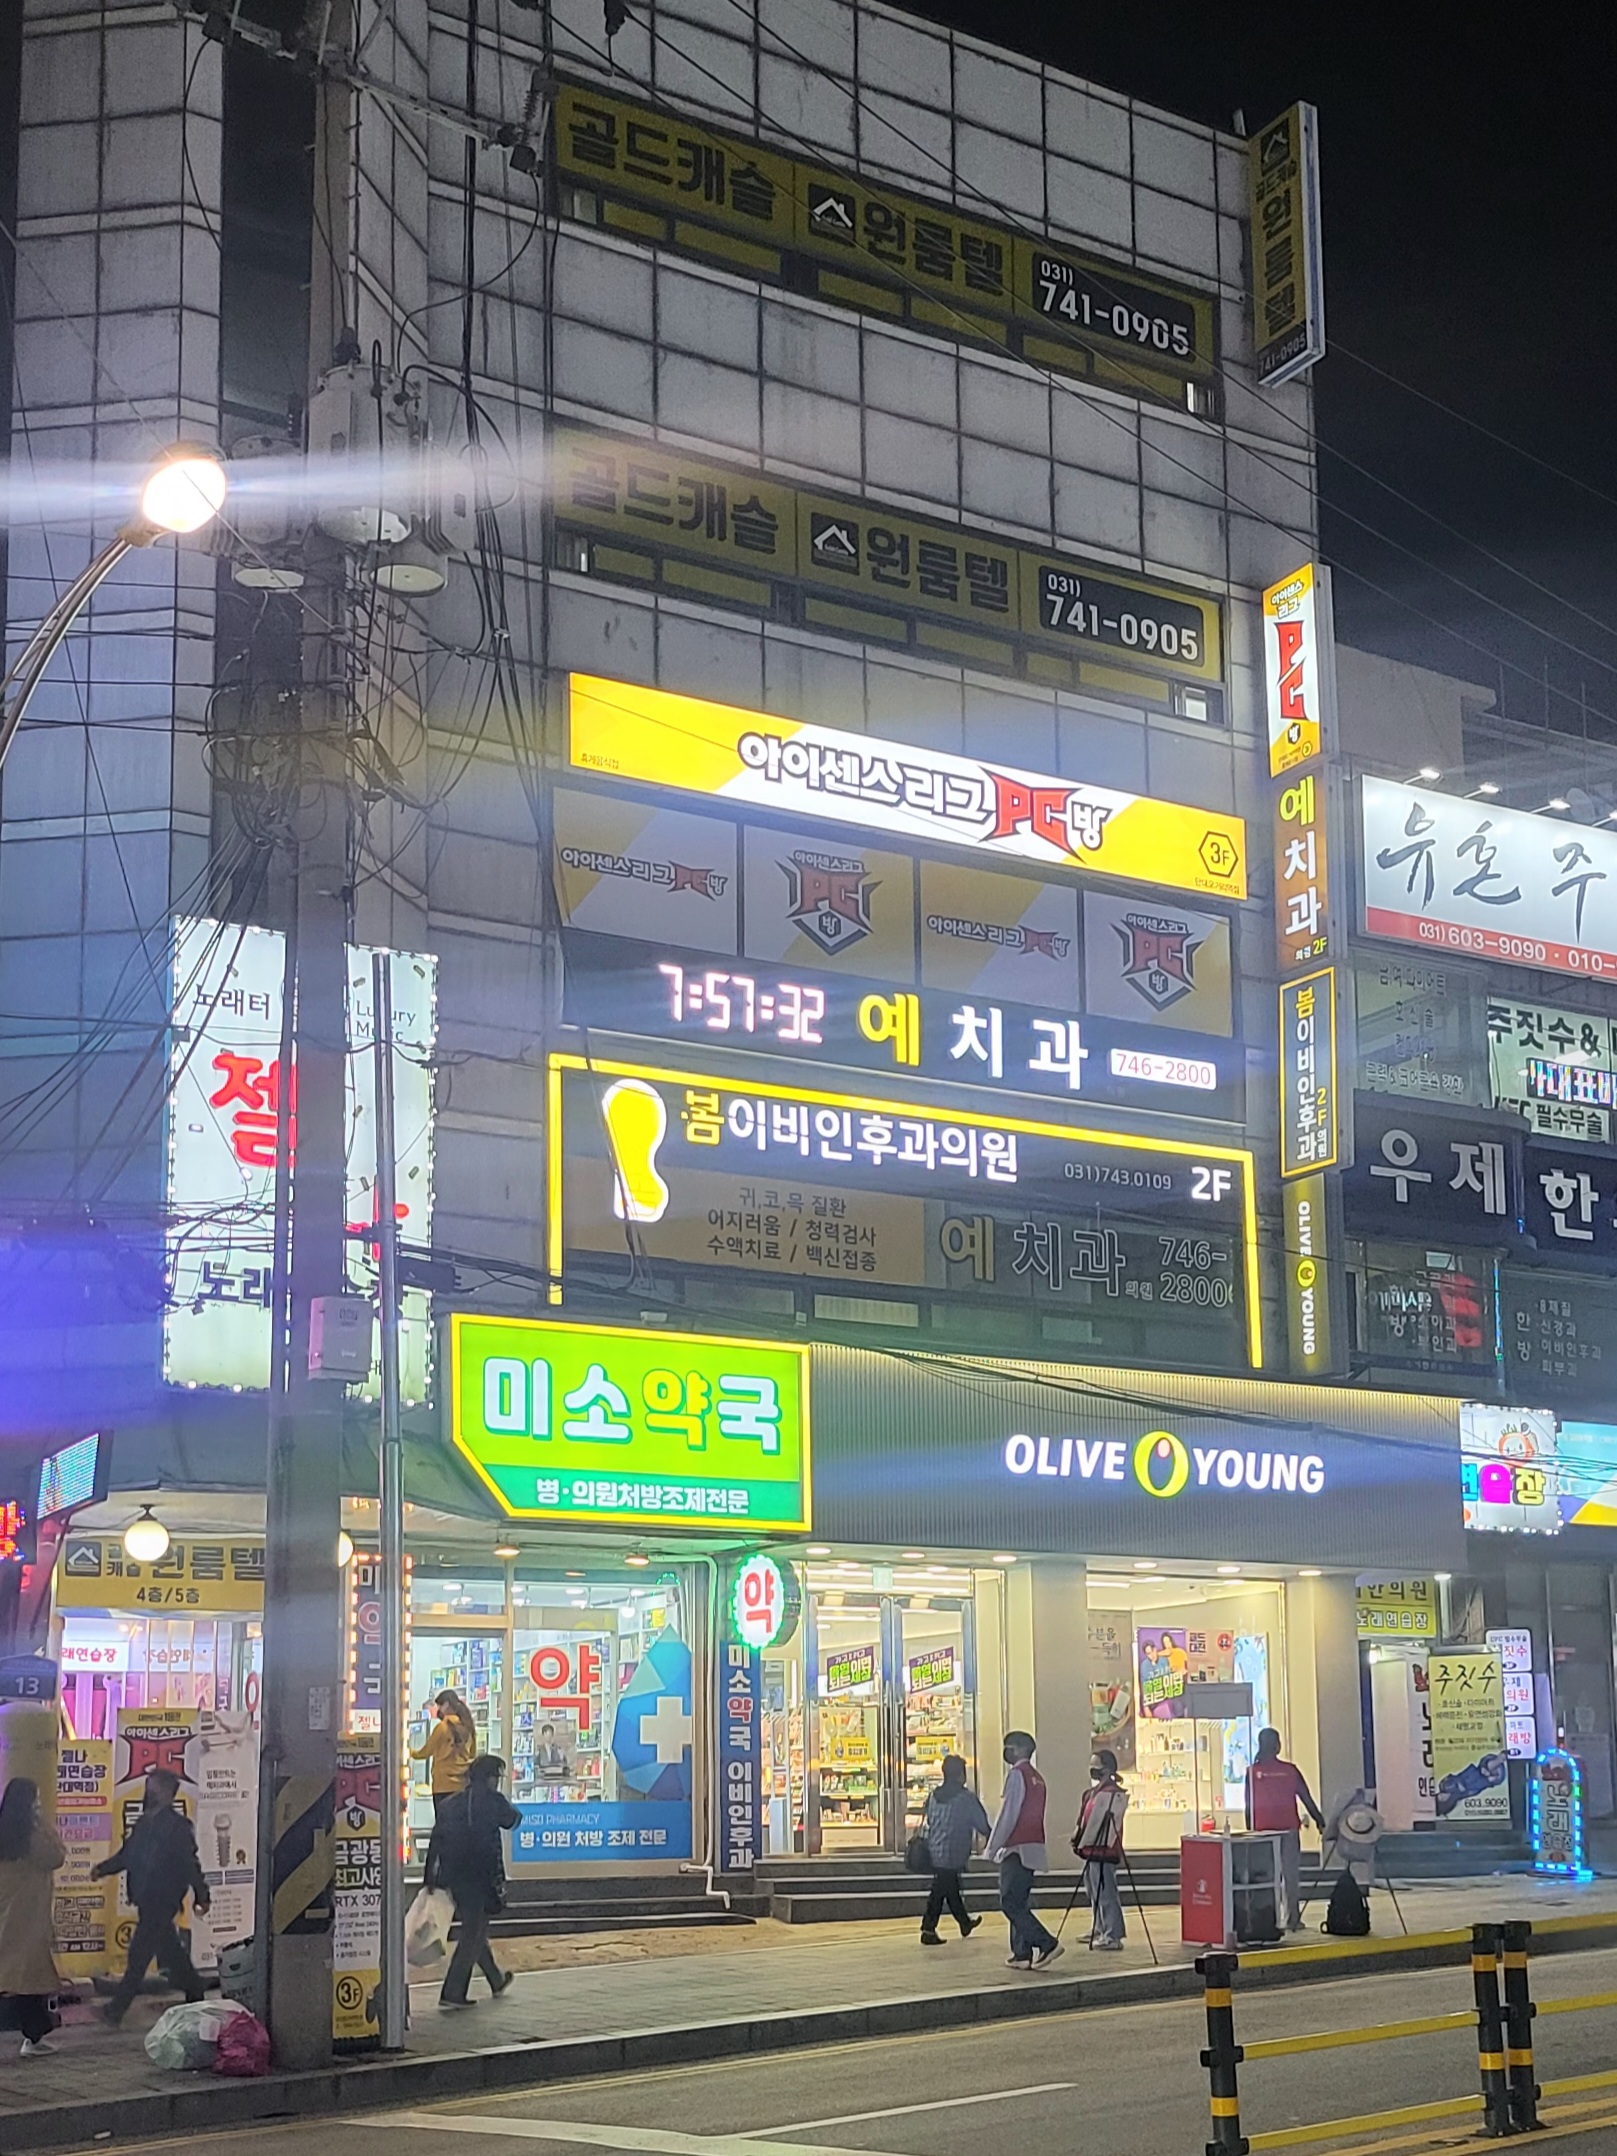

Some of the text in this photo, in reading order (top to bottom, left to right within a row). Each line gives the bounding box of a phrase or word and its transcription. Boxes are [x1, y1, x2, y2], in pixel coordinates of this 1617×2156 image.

[569, 101, 1005, 297] 골드캐슬 원룸텔
[1040, 260, 1074, 286] 031)
[1039, 279, 1190, 357] 741-0905
[570, 448, 1010, 613] 골드캐슬 원룸텔
[1047, 574, 1082, 598] 031)
[1270, 577, 1304, 606] 아이센스
[1277, 598, 1302, 619] 리그
[1046, 593, 1199, 661] 741-0905
[792, 849, 866, 874] 아이센스리그
[1209, 841, 1231, 866] 3F
[1126, 913, 1189, 934] 아이센스리그
[1313, 937, 1328, 955] 2F
[192, 983, 271, 1021] 노래터
[356, 1000, 416, 1025] Luury
[659, 963, 826, 1044] 7:57:32
[356, 1020, 404, 1043] Mic
[1116, 1053, 1212, 1085] 746-2800
[1317, 1087, 1327, 1127] 2F
[1536, 1103, 1603, 1137] 필수무술
[1063, 1162, 1233, 1203] 031)743.0109 2F
[1370, 1129, 1507, 1215] 우제
[739, 1187, 847, 1219] 귀,코,목 질환
[707, 1209, 782, 1238] 어지러움
[805, 1220, 878, 1247] 청력검사
[707, 1234, 782, 1261] 수액치료
[806, 1245, 878, 1272] 백신접종
[1158, 1236, 1228, 1271] 746-
[1125, 1280, 1153, 1301] 의원
[1298, 1200, 1316, 1356] OLIVE YOUNG
[1541, 1319, 1576, 1337] 신경과
[1541, 1339, 1601, 1359] 이비인후과
[483, 1355, 783, 1456] 미소약국
[1004, 1433, 1326, 1495] OLIVE YOUNG
[106, 1561, 142, 1578] 캐슬
[136, 1586, 200, 1604] 4층/5층
[744, 1567, 776, 1634] 약
[14, 1676, 40, 1695] 13
[530, 1644, 602, 1731] 약
[1435, 1660, 1498, 1696] 주짓수
[126, 1726, 190, 1741] 아이센스리그
[546, 1813, 600, 1826] PHARMACY
[727, 1761, 755, 1870] 이비인후과
[574, 1830, 604, 1847] 처방
[607, 1829, 636, 1846] 조제
[639, 1829, 668, 1846] 전문
[341, 1981, 360, 2003] 3F
